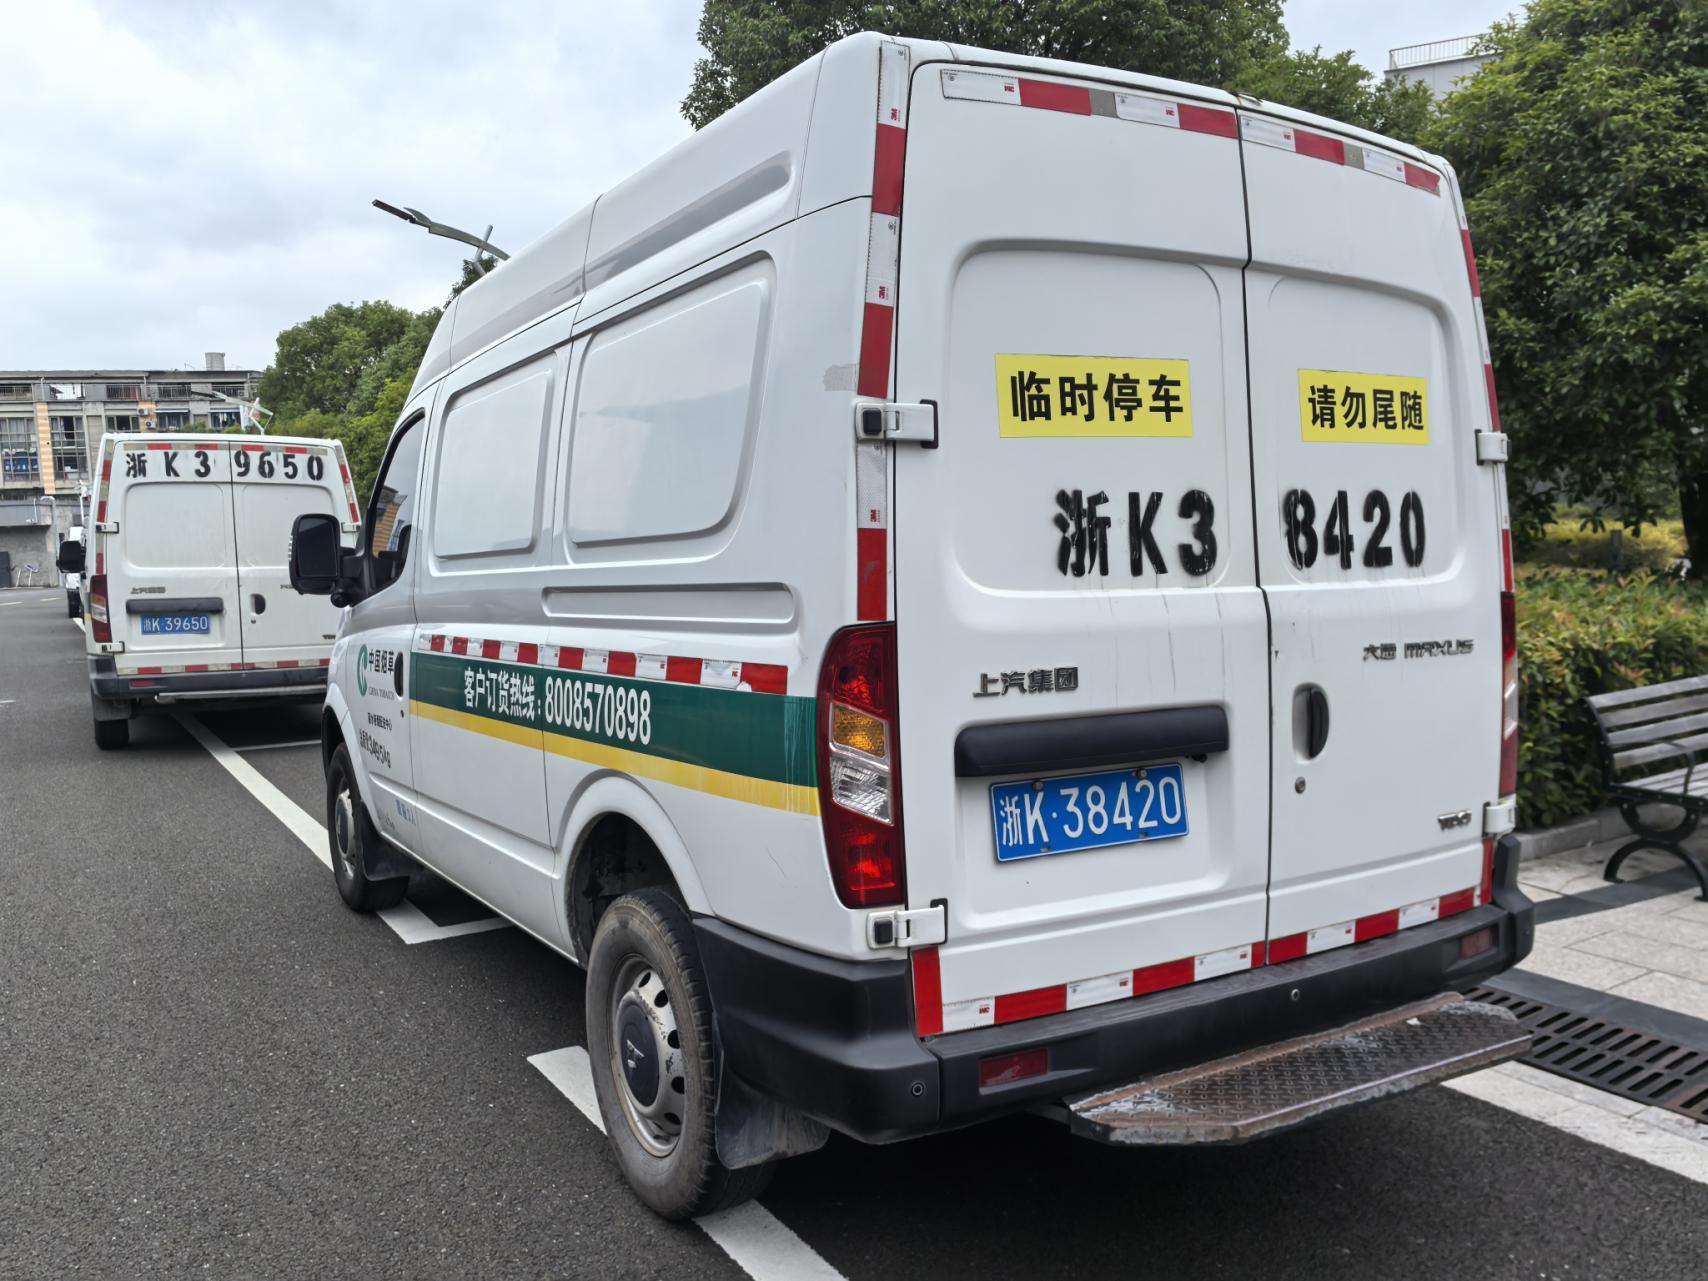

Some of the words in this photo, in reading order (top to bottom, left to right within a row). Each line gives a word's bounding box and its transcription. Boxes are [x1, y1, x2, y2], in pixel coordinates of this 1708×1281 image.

[1010, 370, 1184, 423] 临时停车
[1307, 384, 1424, 430] 请勿尾随
[368, 648, 395, 675] 中国烟草
[972, 666, 1079, 698] 上汽集团
